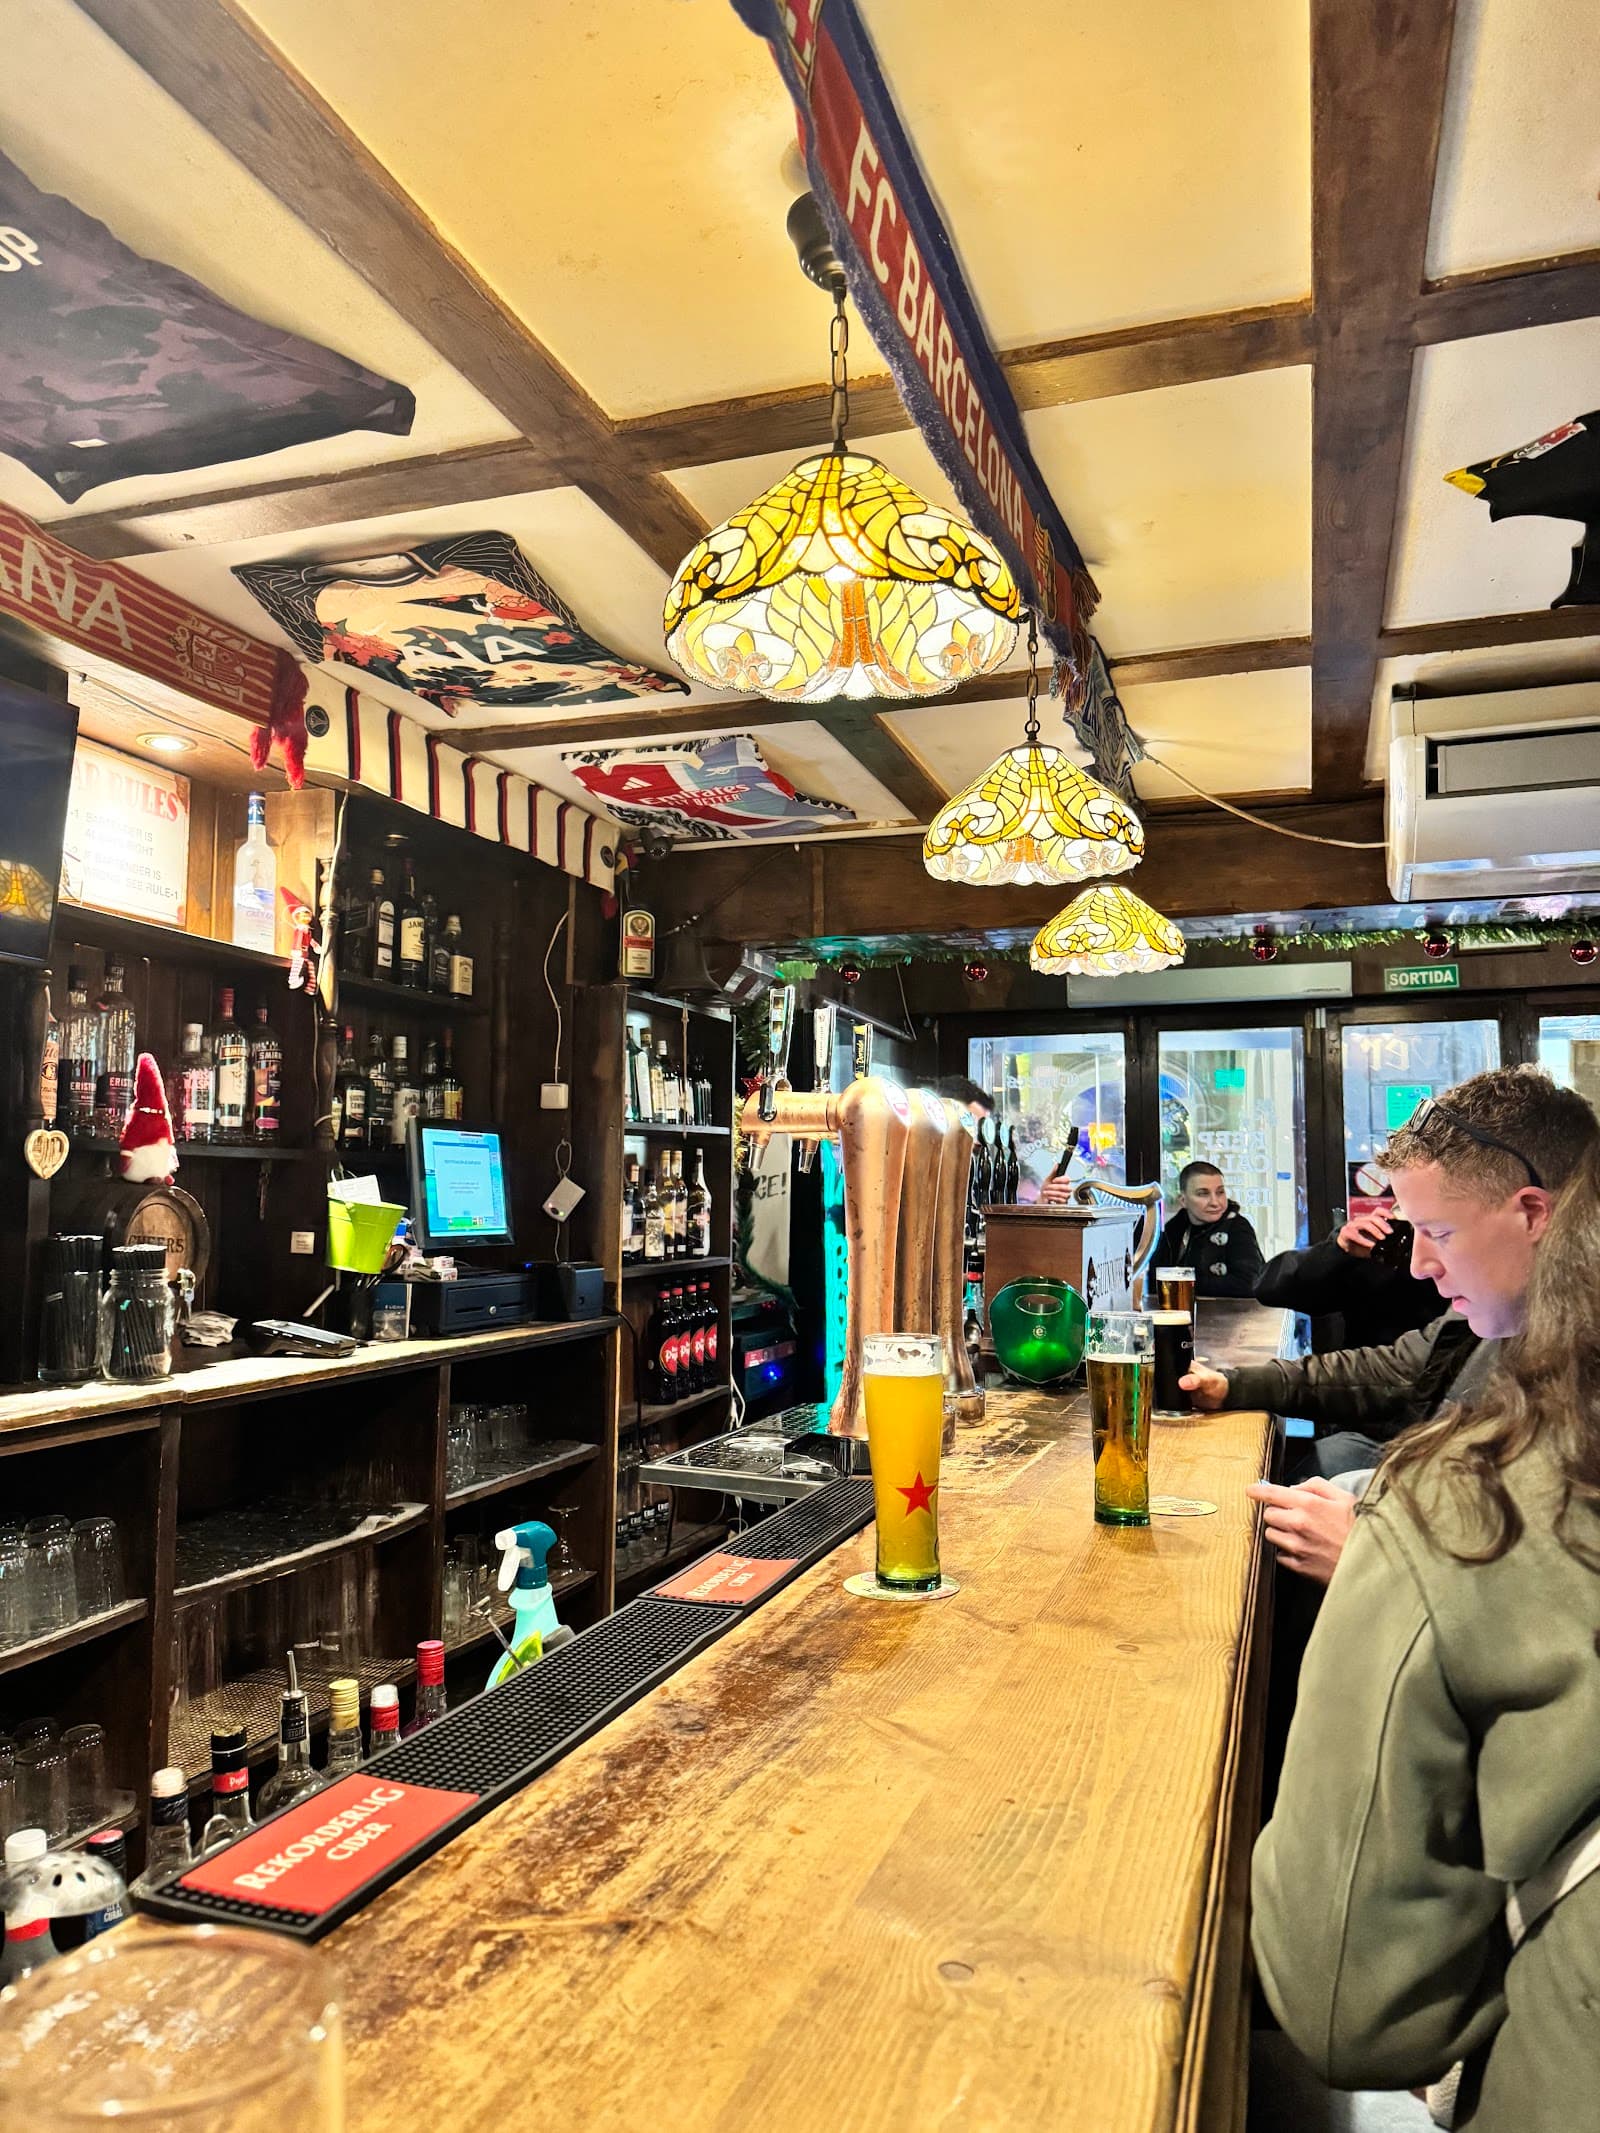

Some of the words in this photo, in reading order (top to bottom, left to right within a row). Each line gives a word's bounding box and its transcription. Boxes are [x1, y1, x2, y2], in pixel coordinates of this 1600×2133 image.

[847, 116, 897, 285] FC
[898, 229, 1025, 553] BARCELONA
[639, 784, 751, 805] Emirates
[692, 793, 740, 806] BETTER
[1389, 970, 1455, 986] SORTIDA
[686, 1560, 753, 1597] REKORDERLIG
[727, 1572, 756, 1587] CIDER
[233, 1787, 406, 1890] REKORDERLIG
[326, 1822, 392, 1861] CIDER
